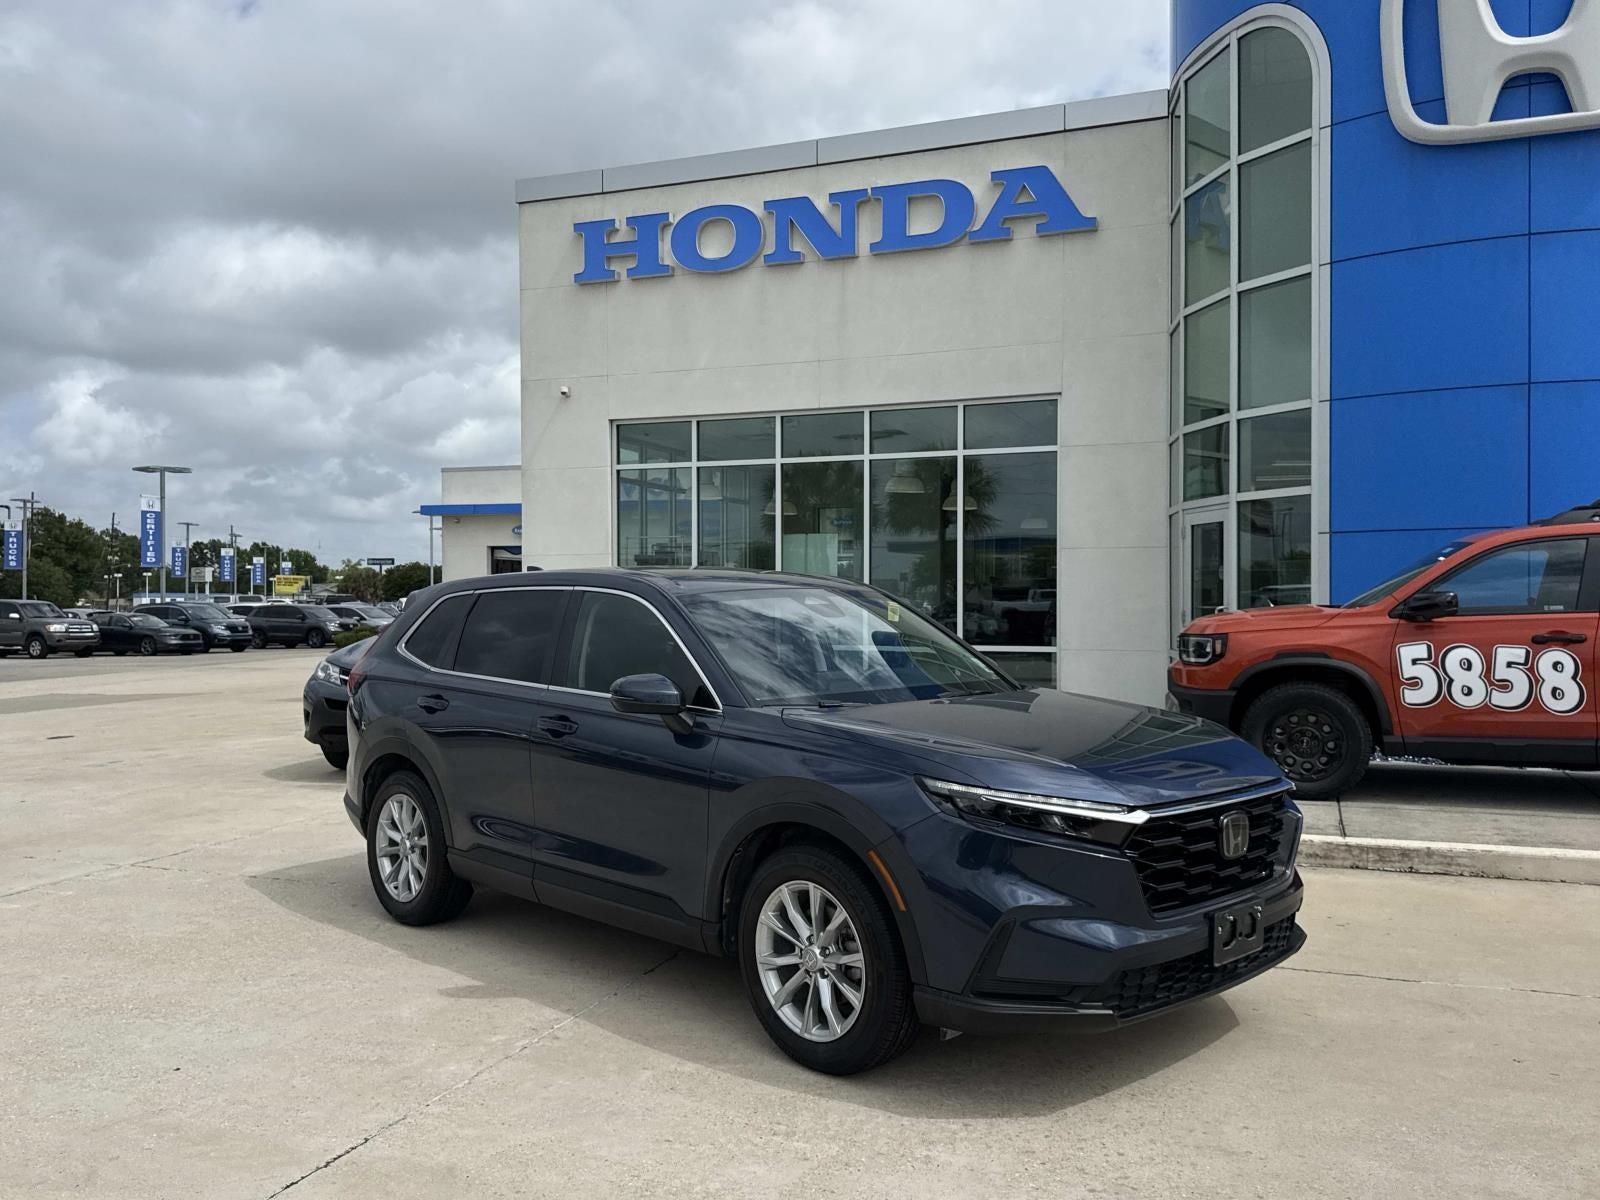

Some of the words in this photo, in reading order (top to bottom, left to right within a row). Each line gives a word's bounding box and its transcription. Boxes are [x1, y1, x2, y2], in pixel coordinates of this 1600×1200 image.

[573, 165, 1097, 284] HONDA
[8, 531, 17, 567] TRUCKS
[146, 512, 156, 563] CERTIFIED
[174, 548, 182, 576] TRUCKS
[1396, 641, 1586, 715] 5858
